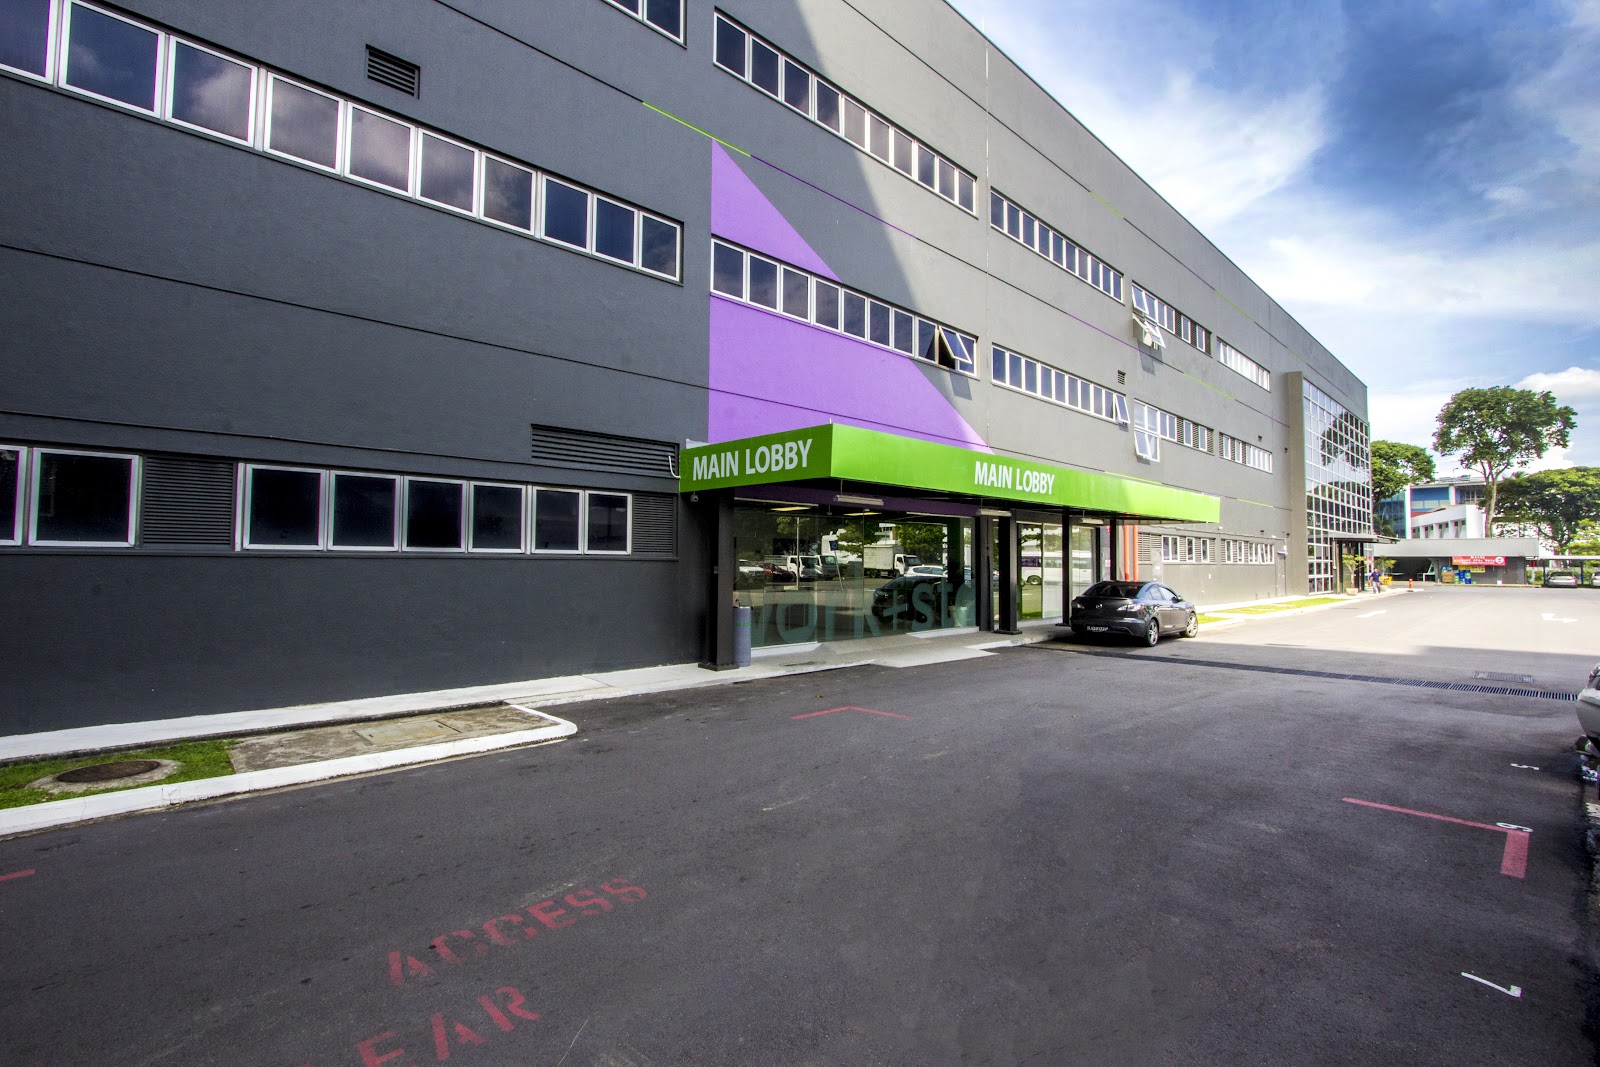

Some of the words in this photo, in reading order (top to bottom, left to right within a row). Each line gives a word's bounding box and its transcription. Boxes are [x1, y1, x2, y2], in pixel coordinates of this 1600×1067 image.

[693, 451, 739, 481] MAIN
[745, 438, 812, 475] LOBBY
[974, 460, 1013, 489] MAIN
[1015, 467, 1055, 495] LOBBY
[387, 877, 648, 986] ACCESS
